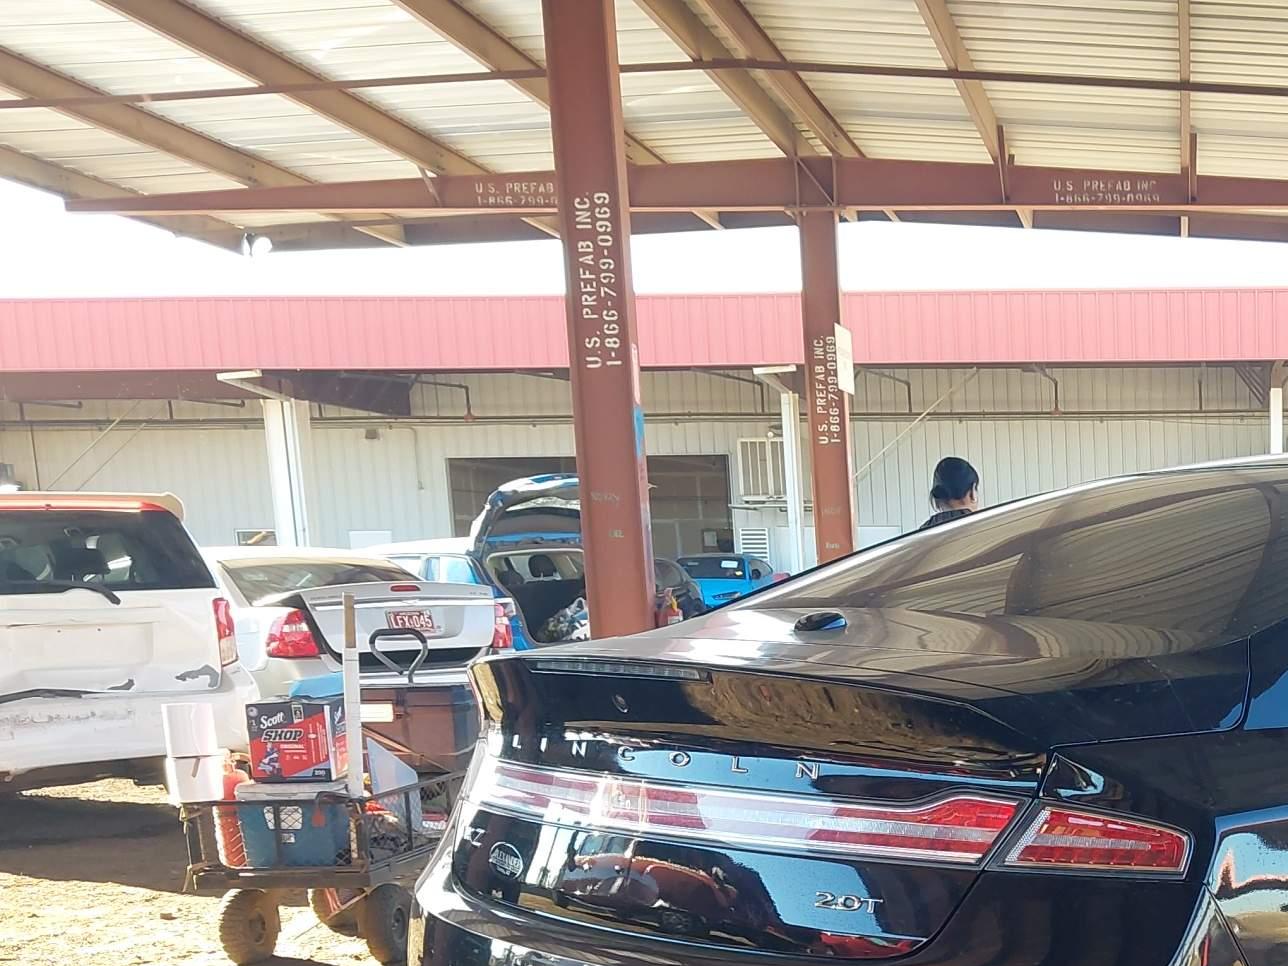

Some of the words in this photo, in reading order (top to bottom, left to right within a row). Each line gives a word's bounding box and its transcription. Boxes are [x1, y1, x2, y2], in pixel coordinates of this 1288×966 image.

[506, 182, 554, 194] PREFAB
[578, 241, 599, 319] PREFAB
[594, 192, 622, 367] 1-866-799-0969
[585, 331, 602, 369] U.S.
[814, 365, 828, 415] PREFAB
[826, 336, 841, 443] 1-866-799-0969
[818, 420, 829, 444] U.S.
[260, 711, 285, 729] Scott
[262, 728, 304, 742] SHOP
[512, 735, 820, 780] LINCOLN
